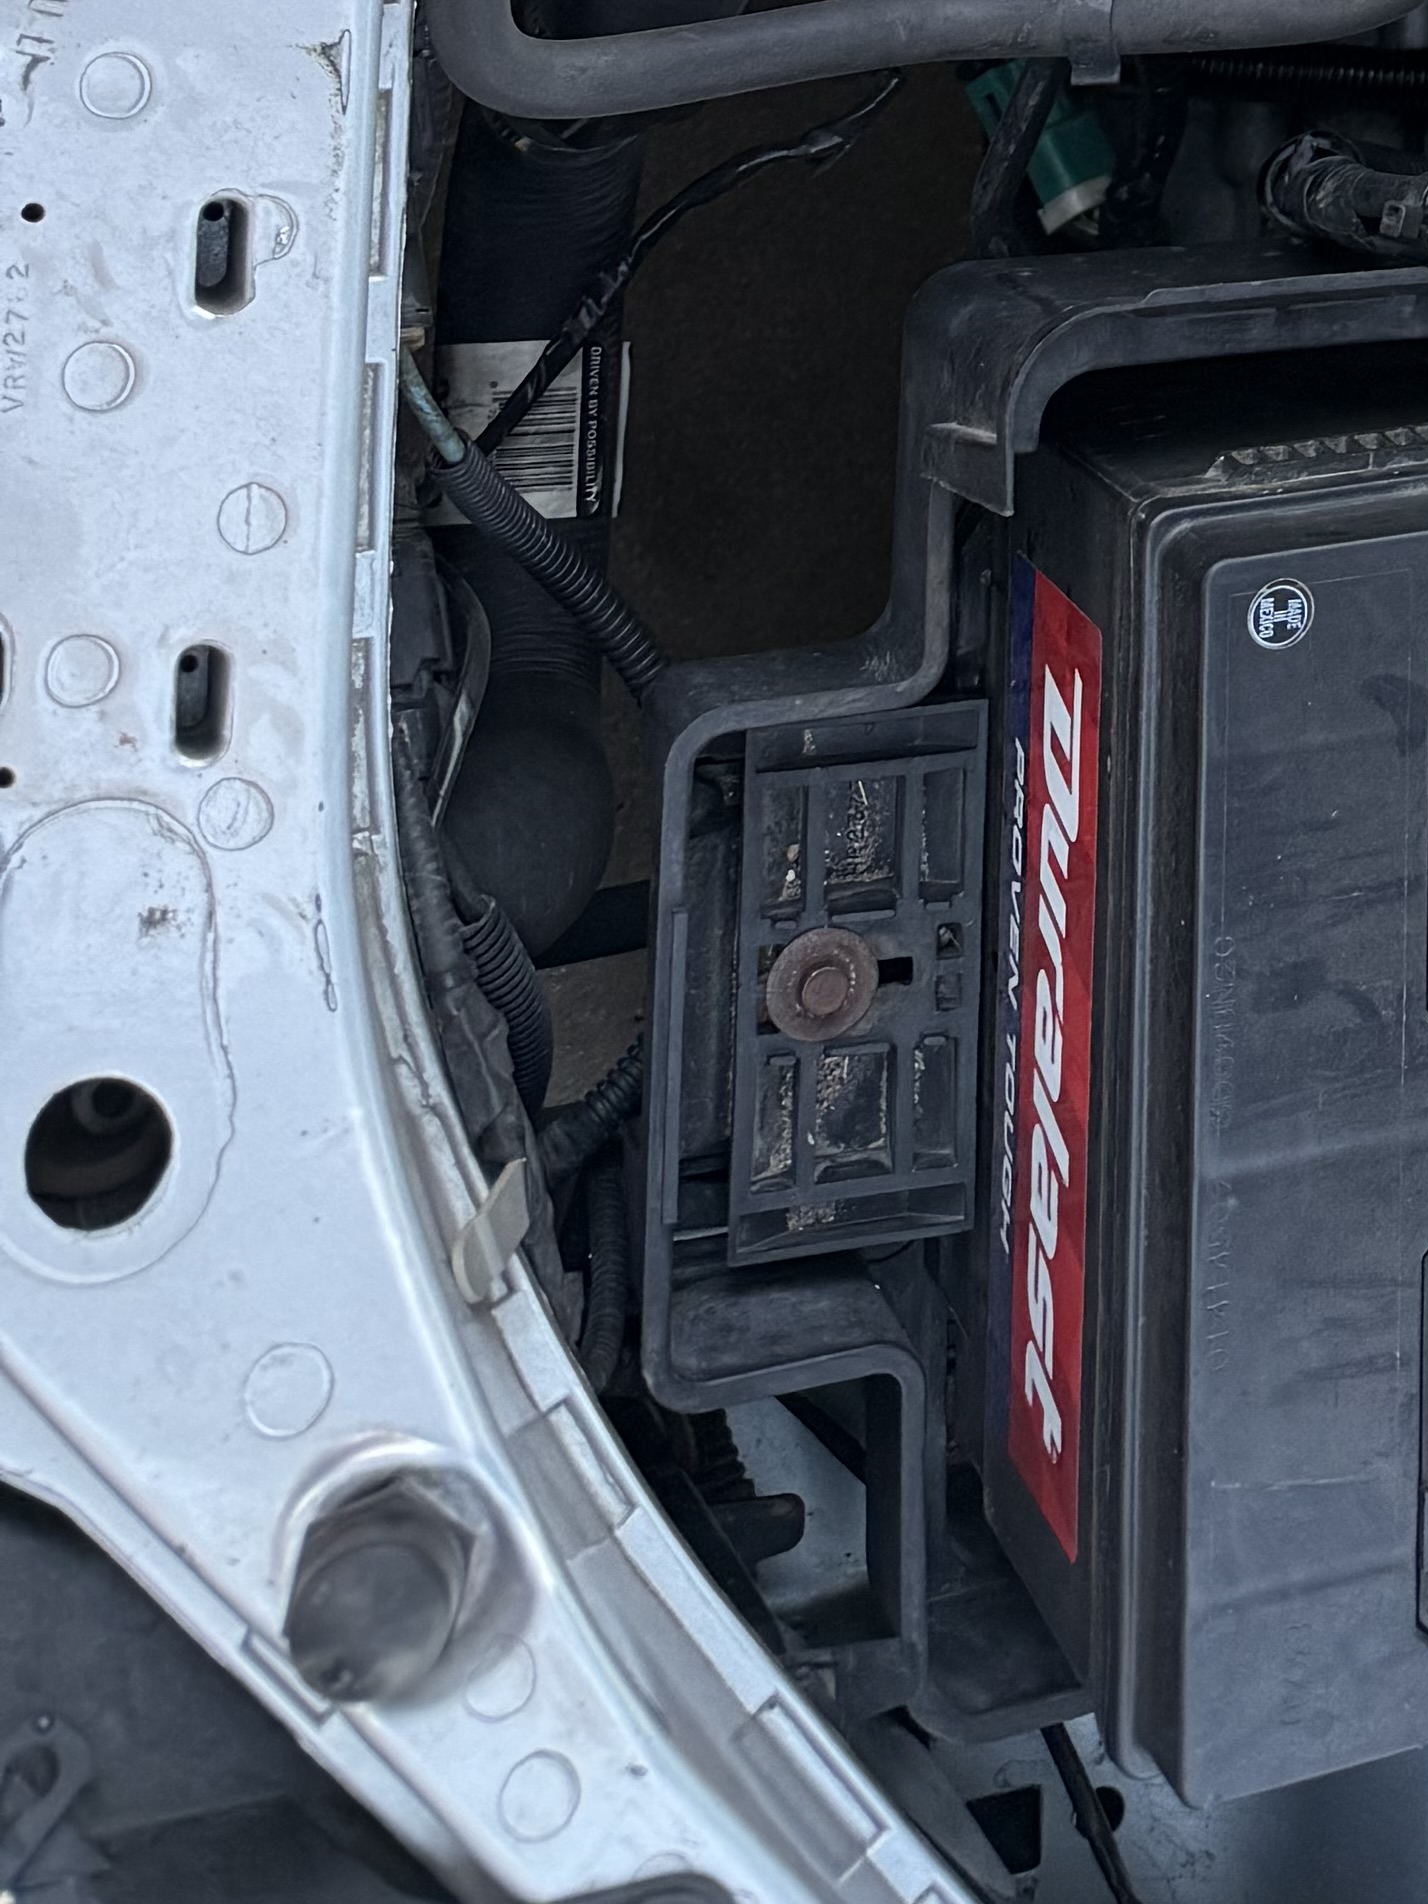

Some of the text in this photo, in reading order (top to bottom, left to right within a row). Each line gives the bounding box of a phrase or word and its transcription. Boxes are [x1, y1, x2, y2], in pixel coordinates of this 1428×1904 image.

[589, 345, 602, 396] DRIVEN
[583, 419, 598, 502] POSSIBILITY
[1257, 596, 1275, 638] MEXICO
[1286, 597, 1302, 630] MADE
[999, 737, 1025, 1257] PROVEN TOUGH
[1022, 663, 1083, 1466] Duralast
